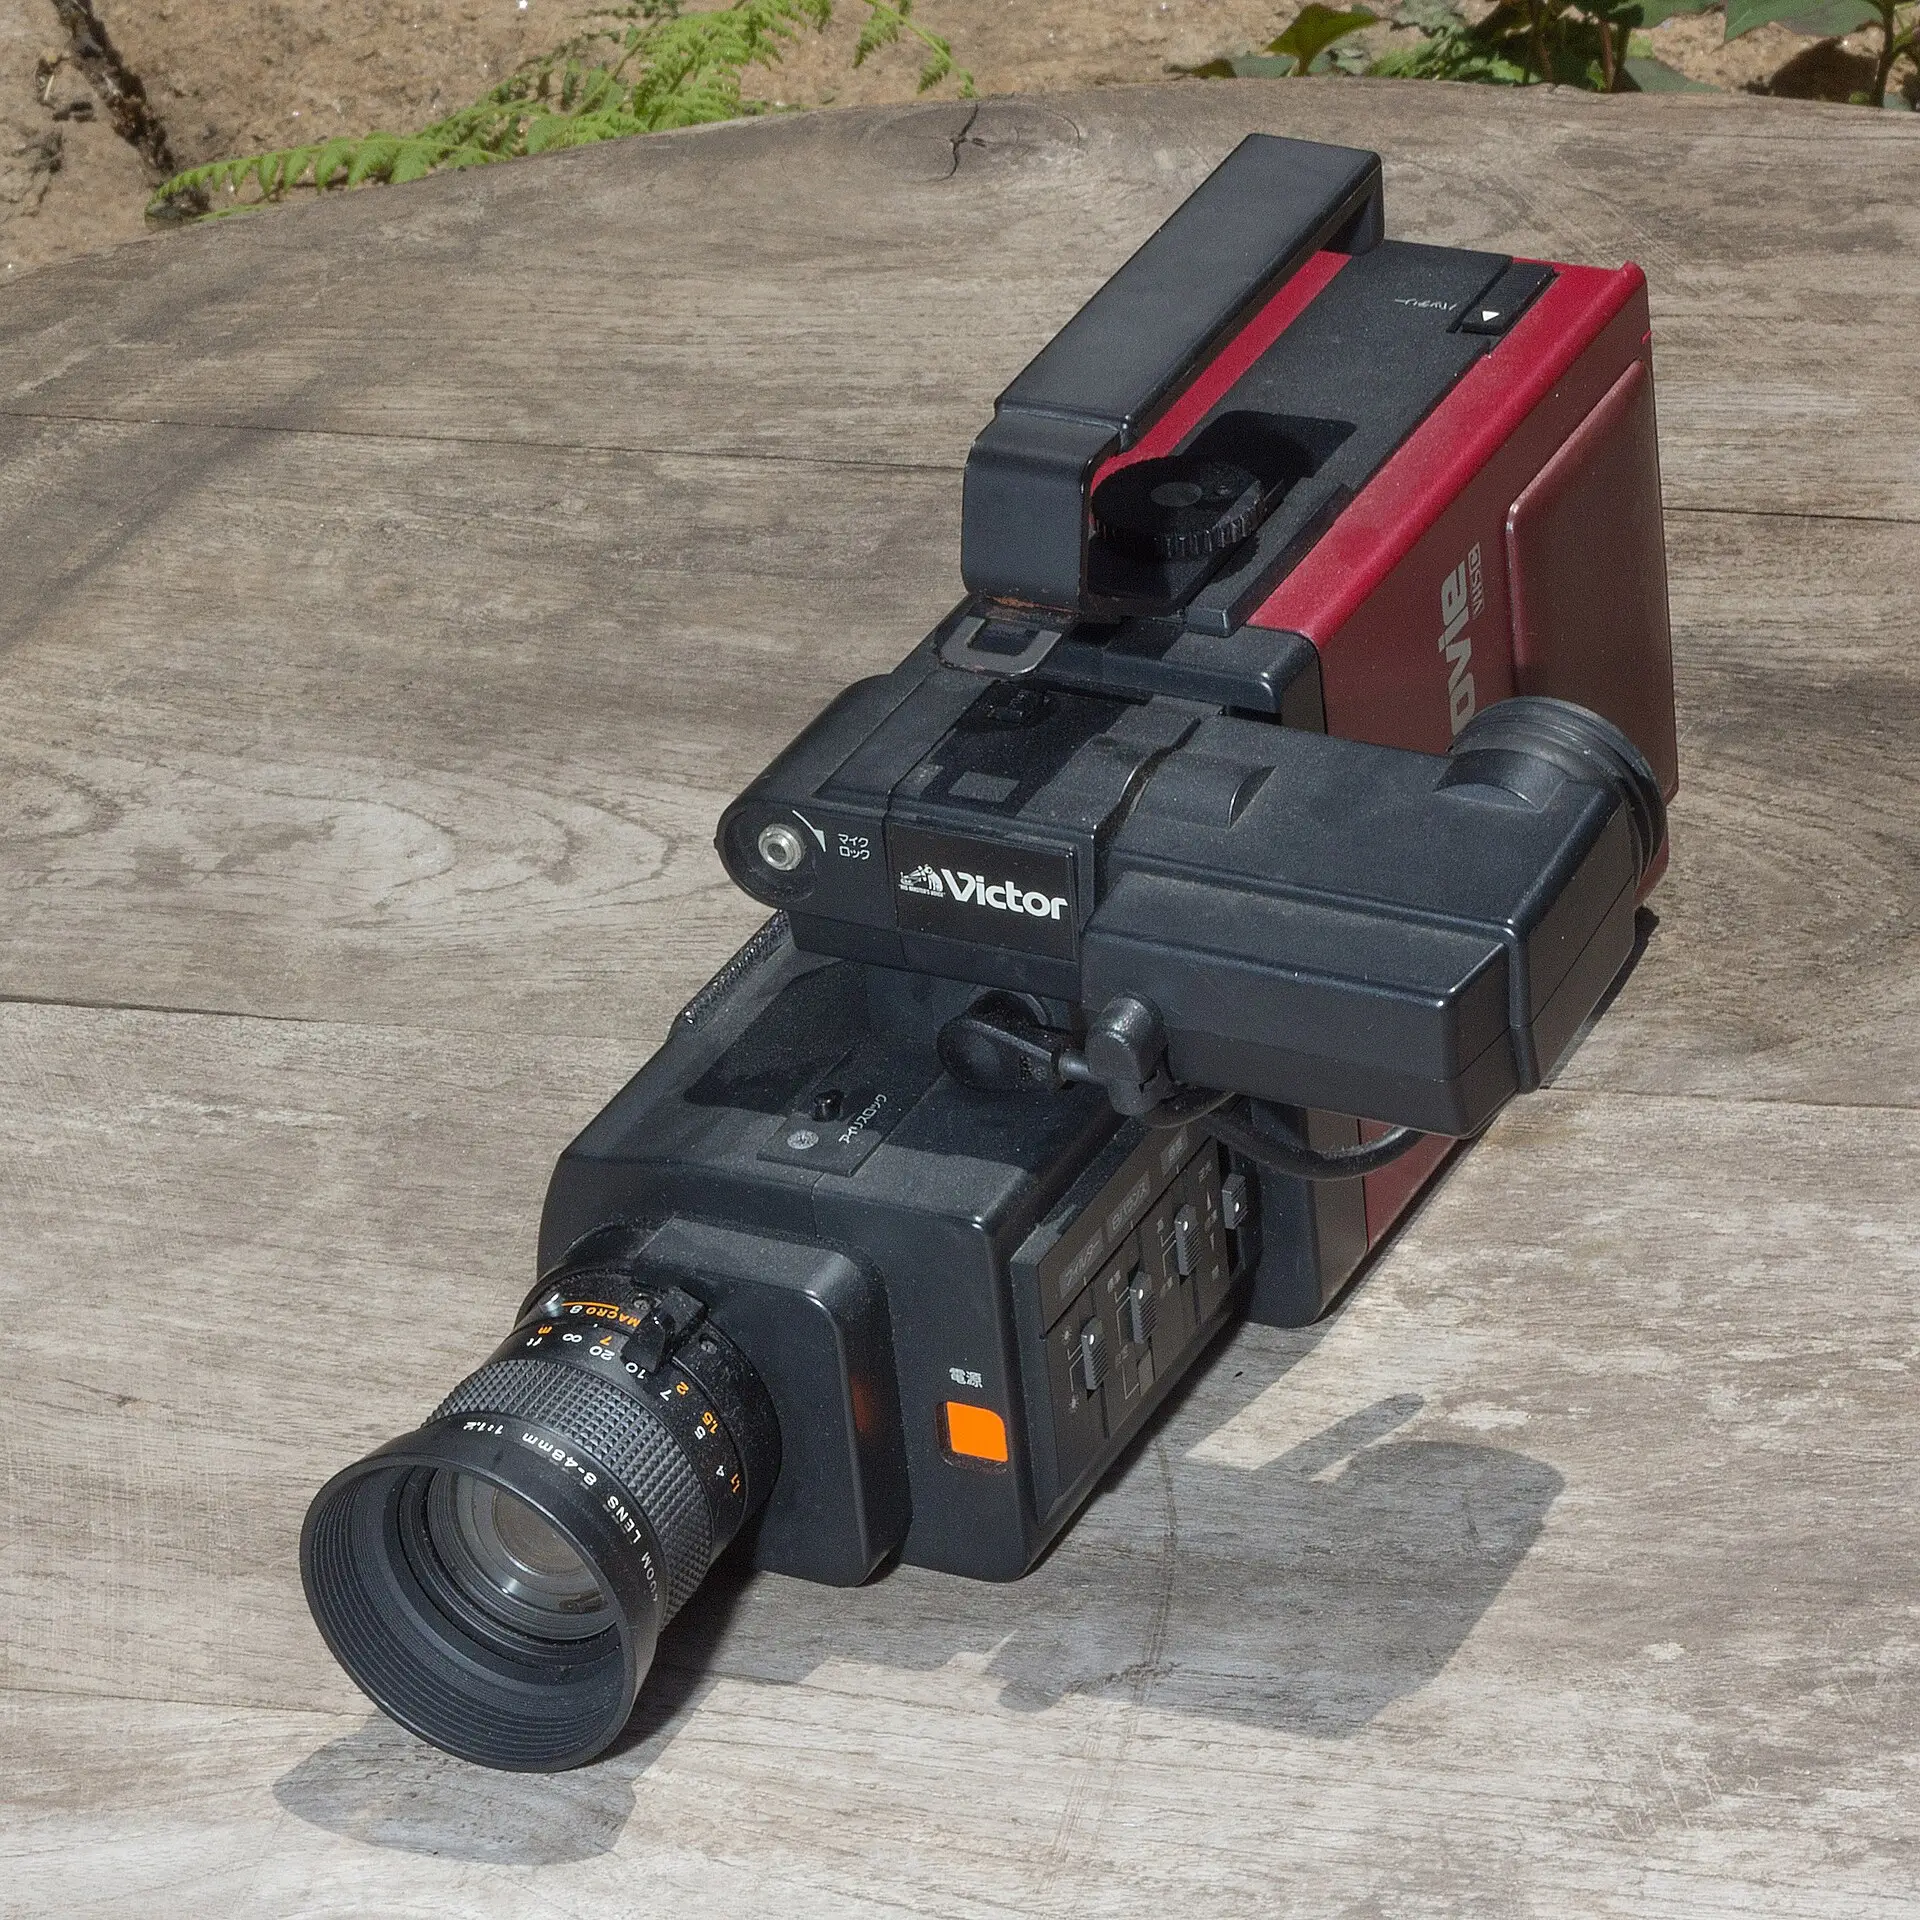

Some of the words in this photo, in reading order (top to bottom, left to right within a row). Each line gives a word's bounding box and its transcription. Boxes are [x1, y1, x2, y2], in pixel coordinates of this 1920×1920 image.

[1438, 560, 1476, 736] ovie
[838, 833, 869, 848] マイク
[839, 845, 871, 860] ロック
[940, 868, 1069, 920] Victor
[838, 1094, 888, 1144] アイリスロック
[586, 1306, 641, 1327] MACRO
[538, 1326, 552, 1334] m
[600, 1336, 613, 1346] 7
[589, 1345, 615, 1361] 20
[625, 1362, 646, 1379] 10
[949, 1367, 983, 1389] 電源
[660, 1389, 672, 1401] 7
[676, 1381, 689, 1396] 2
[463, 1421, 504, 1435] 1:1.2
[702, 1411, 719, 1434] 1.5
[694, 1425, 706, 1440] 5
[522, 1432, 598, 1486] 8-48mm
[716, 1465, 725, 1477] 4
[607, 1496, 642, 1544] LENS
